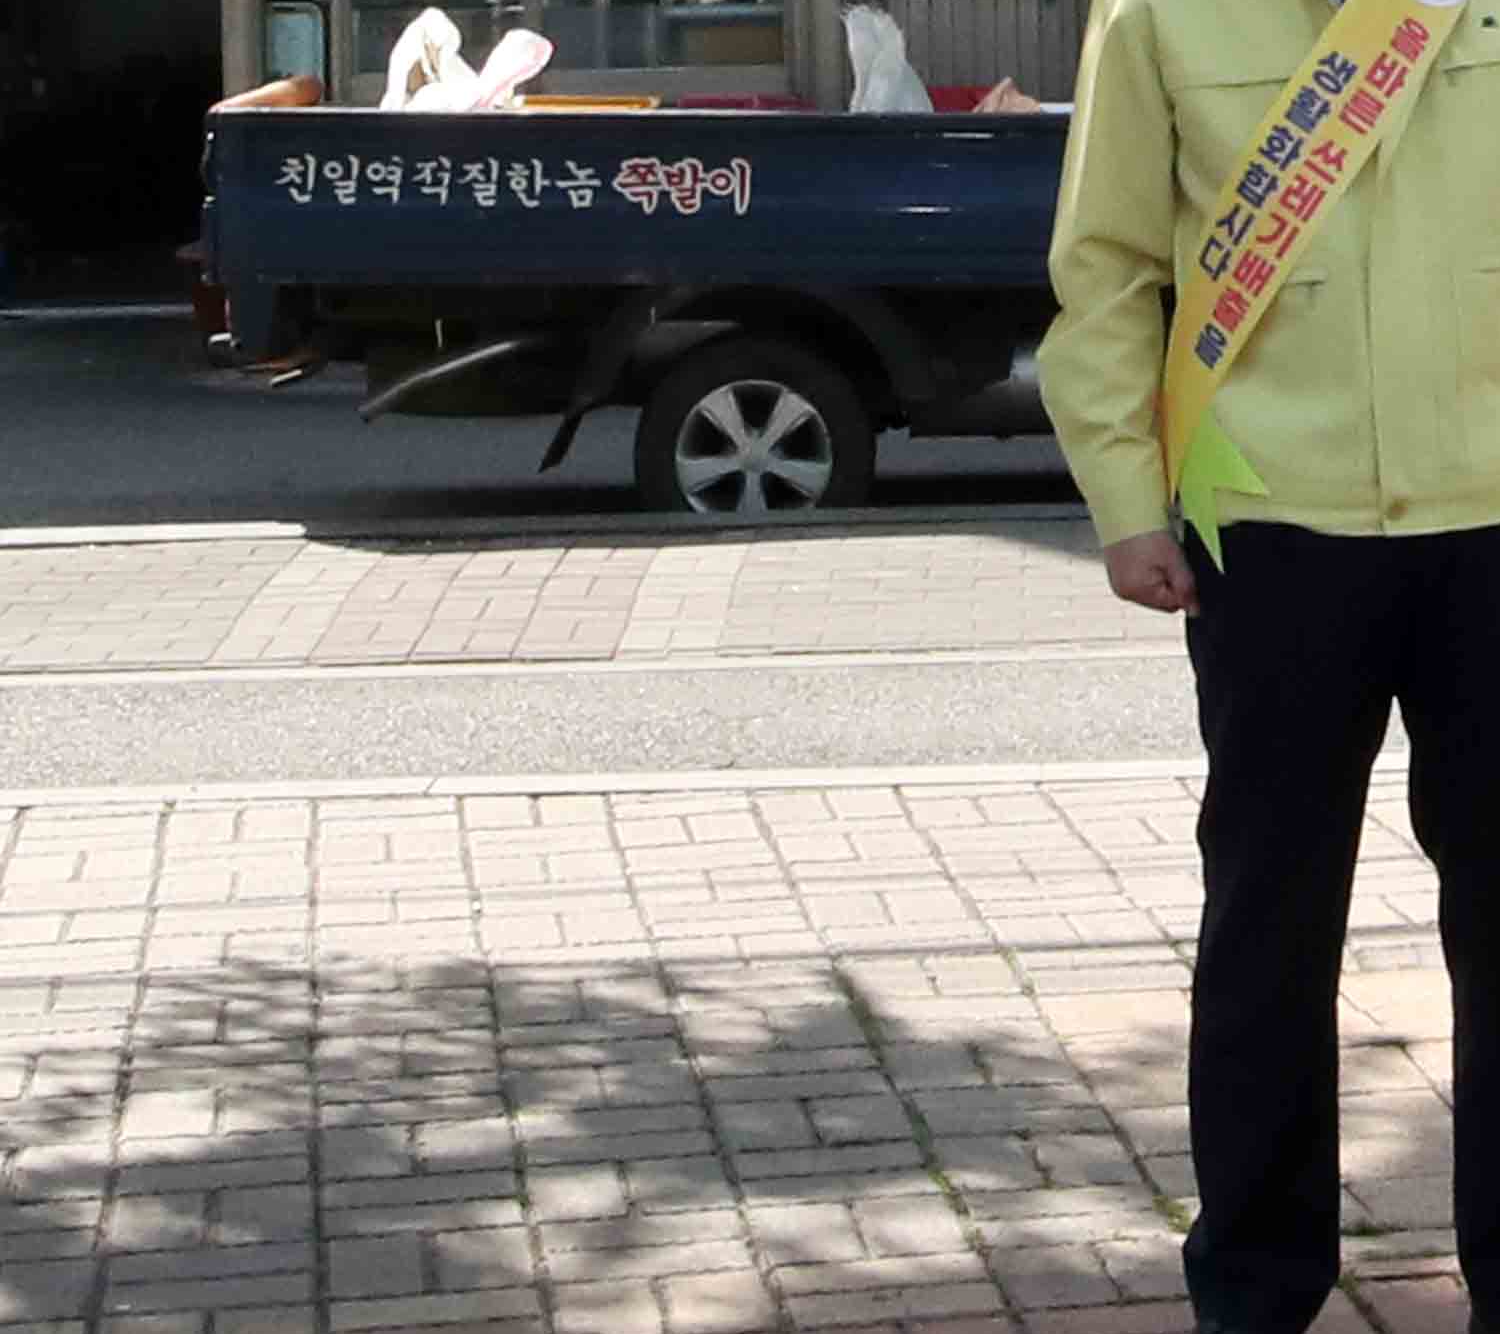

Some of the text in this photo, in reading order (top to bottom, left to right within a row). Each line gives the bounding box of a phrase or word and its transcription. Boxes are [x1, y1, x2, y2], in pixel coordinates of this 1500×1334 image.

[1340, 16, 1431, 136] 올바른
[612, 156, 752, 216] 쪽발이
[1198, 51, 1359, 282] 생활화합시다
